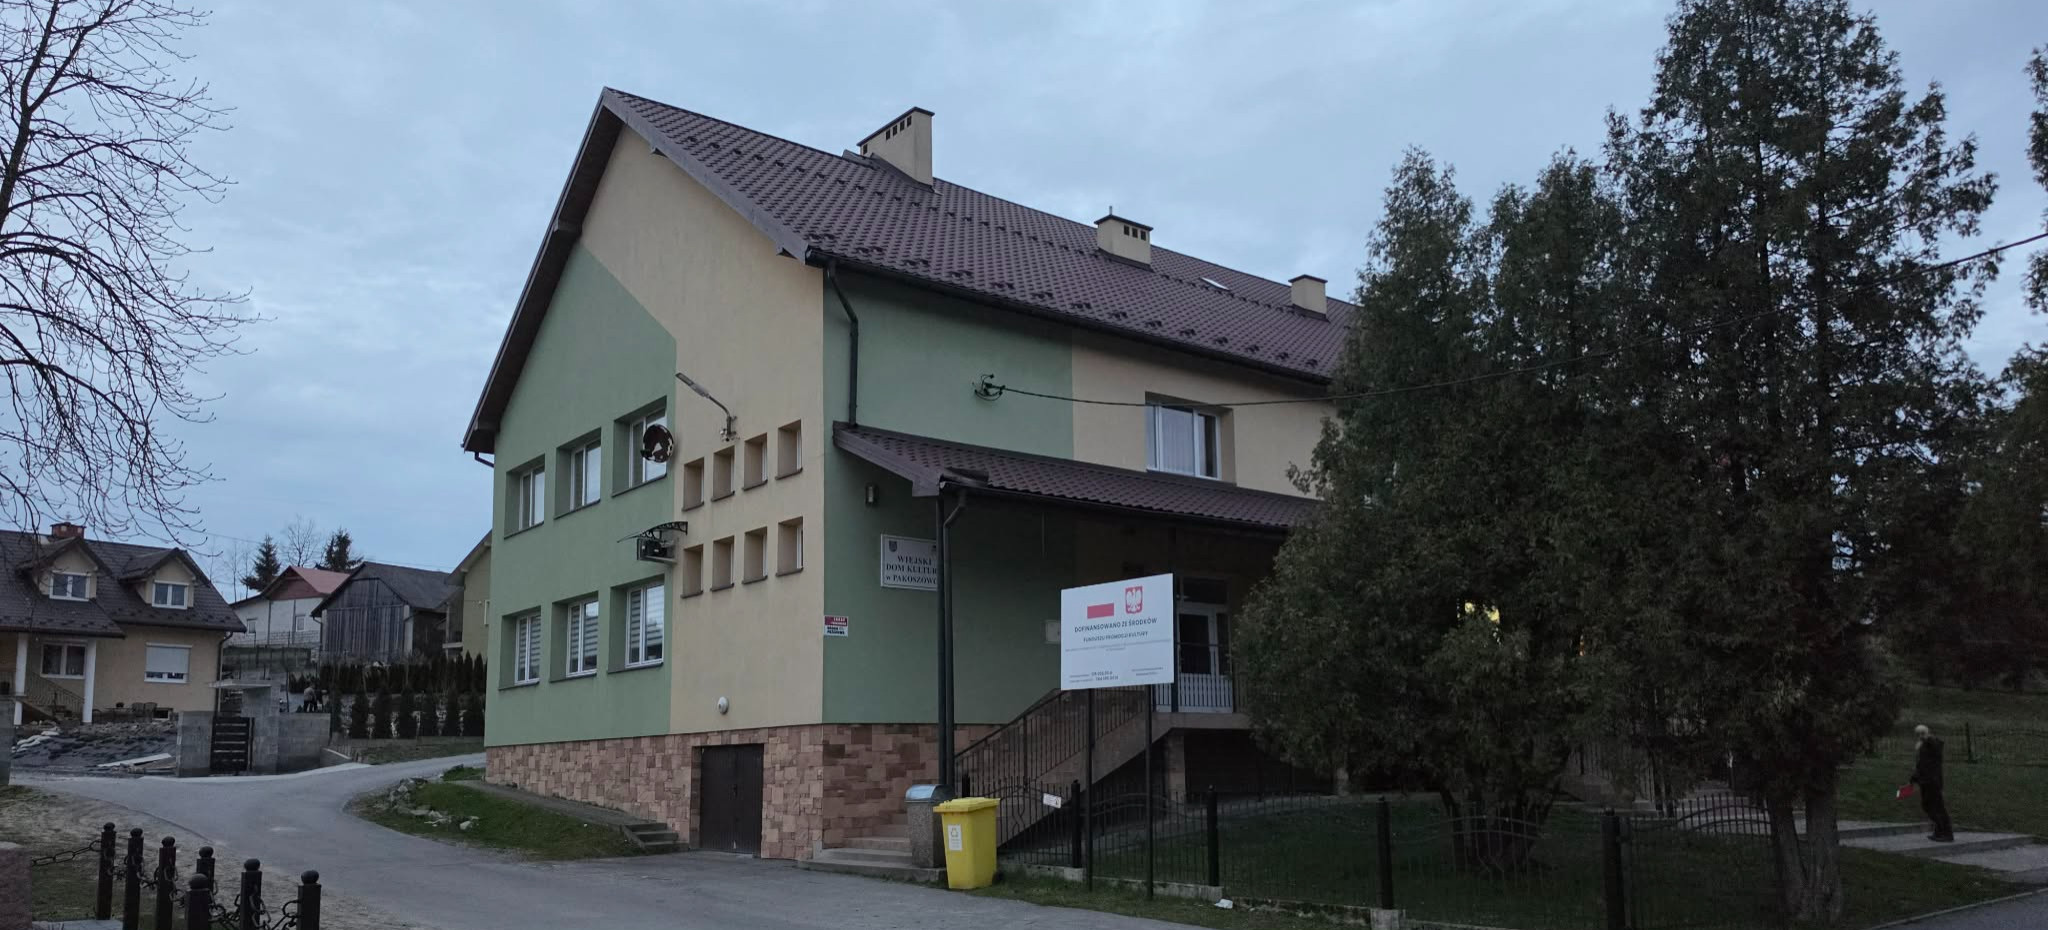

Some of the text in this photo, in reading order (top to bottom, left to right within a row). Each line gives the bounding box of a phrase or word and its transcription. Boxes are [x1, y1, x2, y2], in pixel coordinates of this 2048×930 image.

[898, 555, 931, 566] WIEJSKI
[886, 563, 936, 574] DOM KULTUR
[1074, 618, 1158, 633] DOFINANSOWANO ZE ŚRODKÓW
[1083, 634, 1105, 643] FUNDUSZU
[1105, 632, 1128, 640] PROMOCJI
